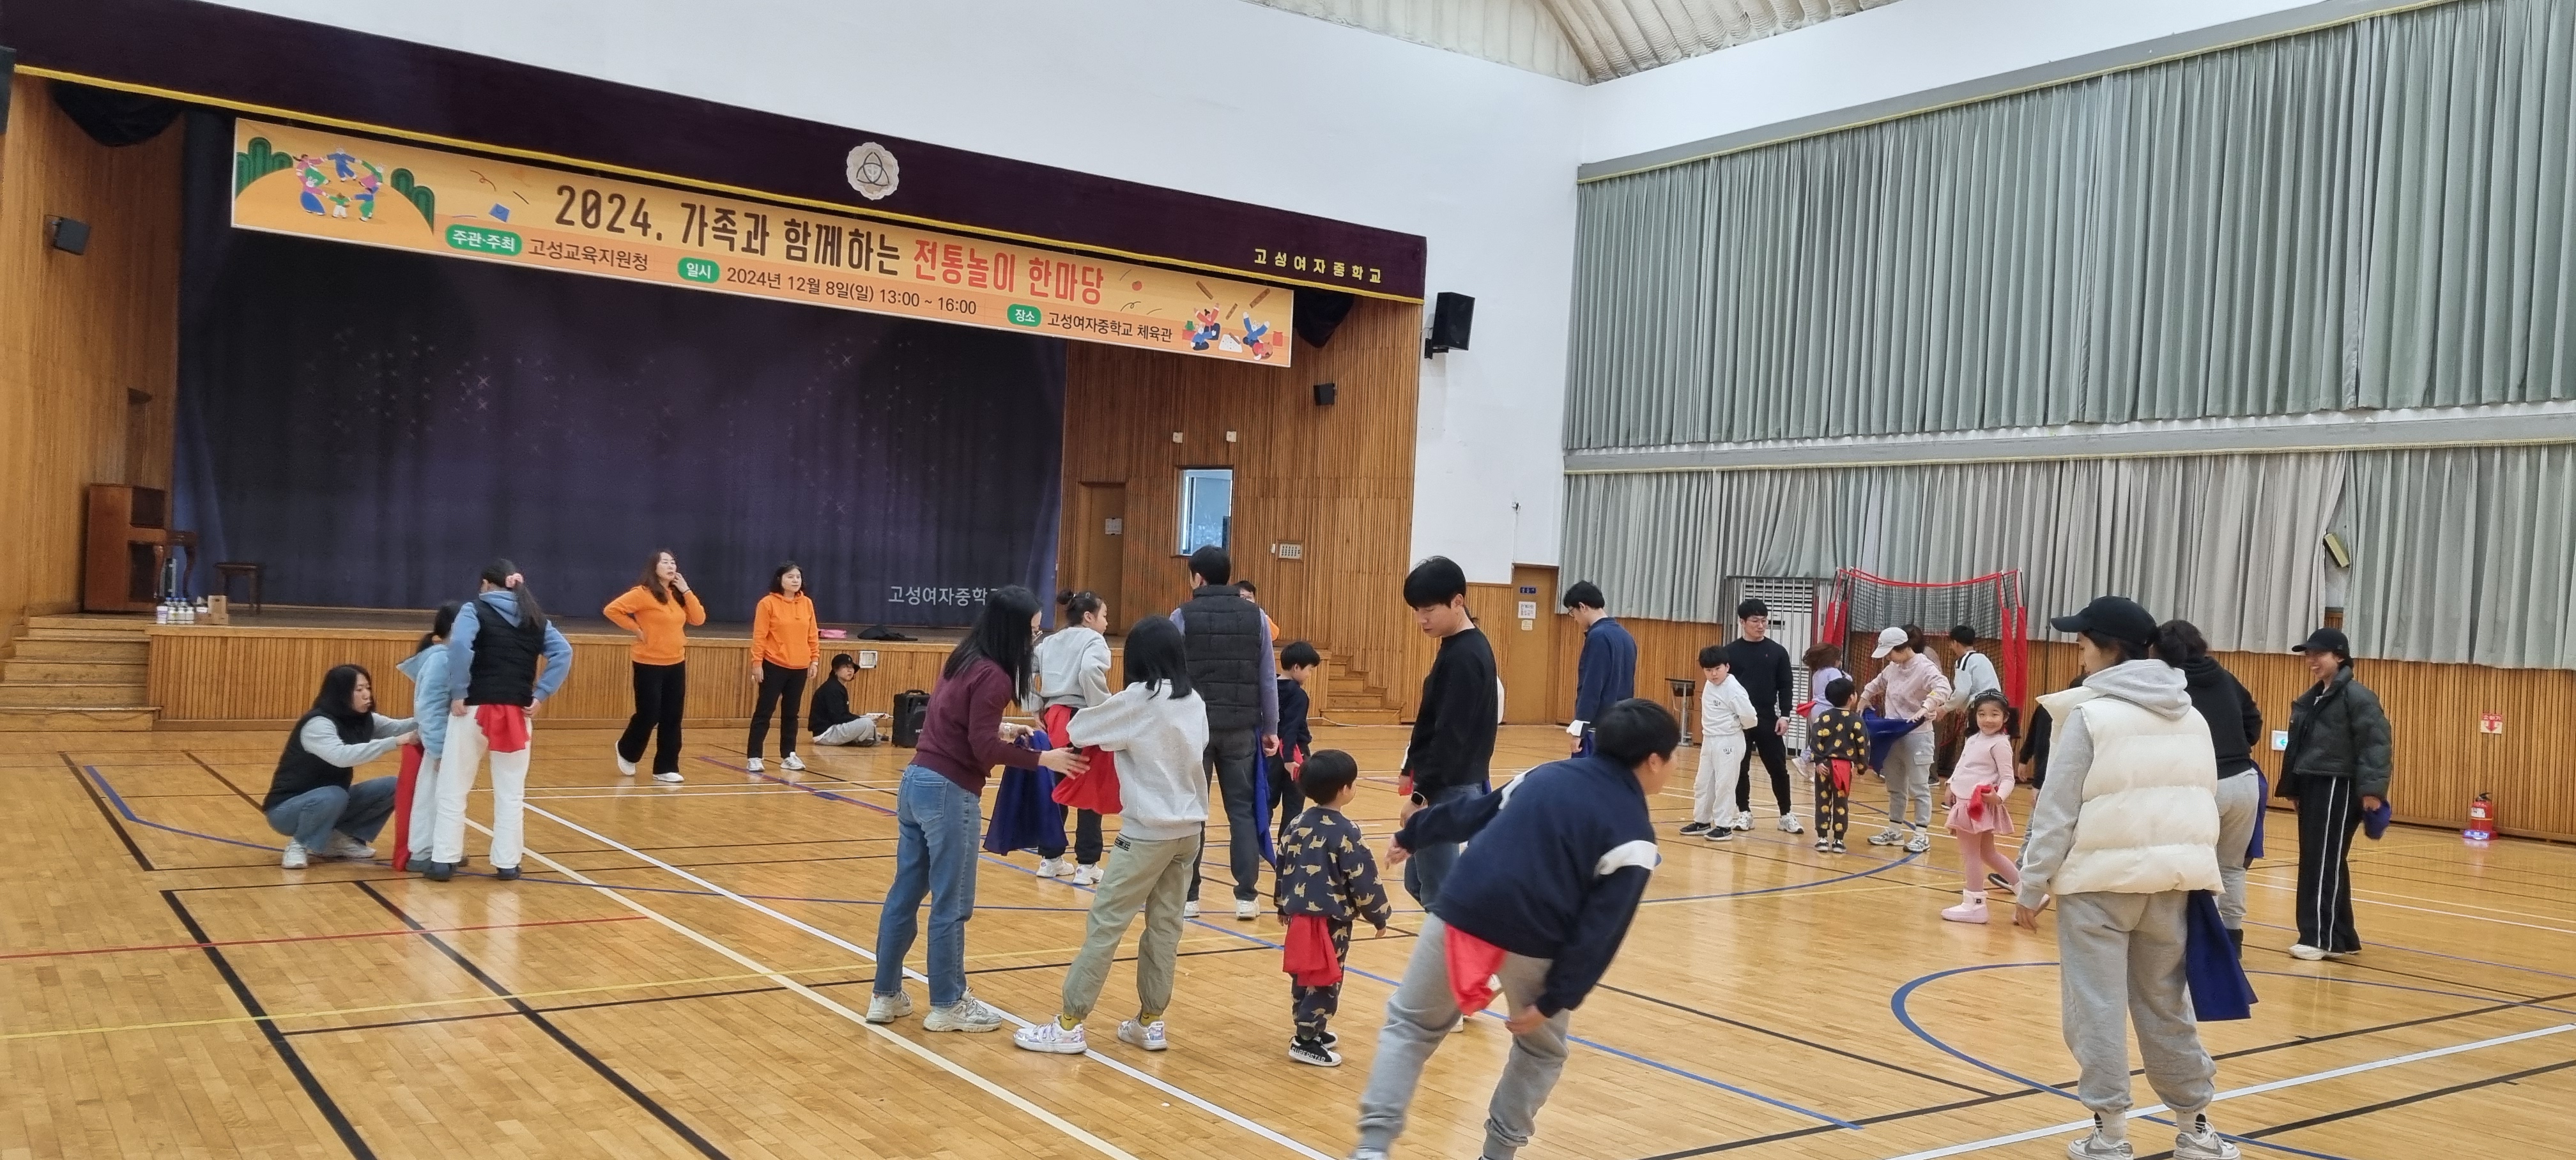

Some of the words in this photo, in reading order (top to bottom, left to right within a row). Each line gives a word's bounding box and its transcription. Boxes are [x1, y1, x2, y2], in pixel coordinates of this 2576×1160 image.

[452, 227, 516, 252] 주관·주최
[527, 238, 648, 271] 고성교육지원청
[555, 184, 663, 241] 2024.
[680, 201, 770, 256] 가족과
[783, 217, 901, 276] 함께하는
[914, 239, 1016, 293] 전통놀이
[1029, 257, 1104, 305] 한마당
[686, 262, 712, 279] 일시
[1254, 248, 1382, 284] 고성여자중학교
[726, 266, 781, 289] 2024년
[788, 276, 821, 295] 12월
[825, 284, 874, 303] 8일(일)
[880, 289, 920, 308] 13:00
[938, 296, 977, 315] 16:00
[1015, 309, 1036, 323] 장소
[1047, 312, 1133, 337] 고성여자중학교
[1137, 324, 1173, 343] 체육관
[888, 586, 999, 606] 고성여자중학
